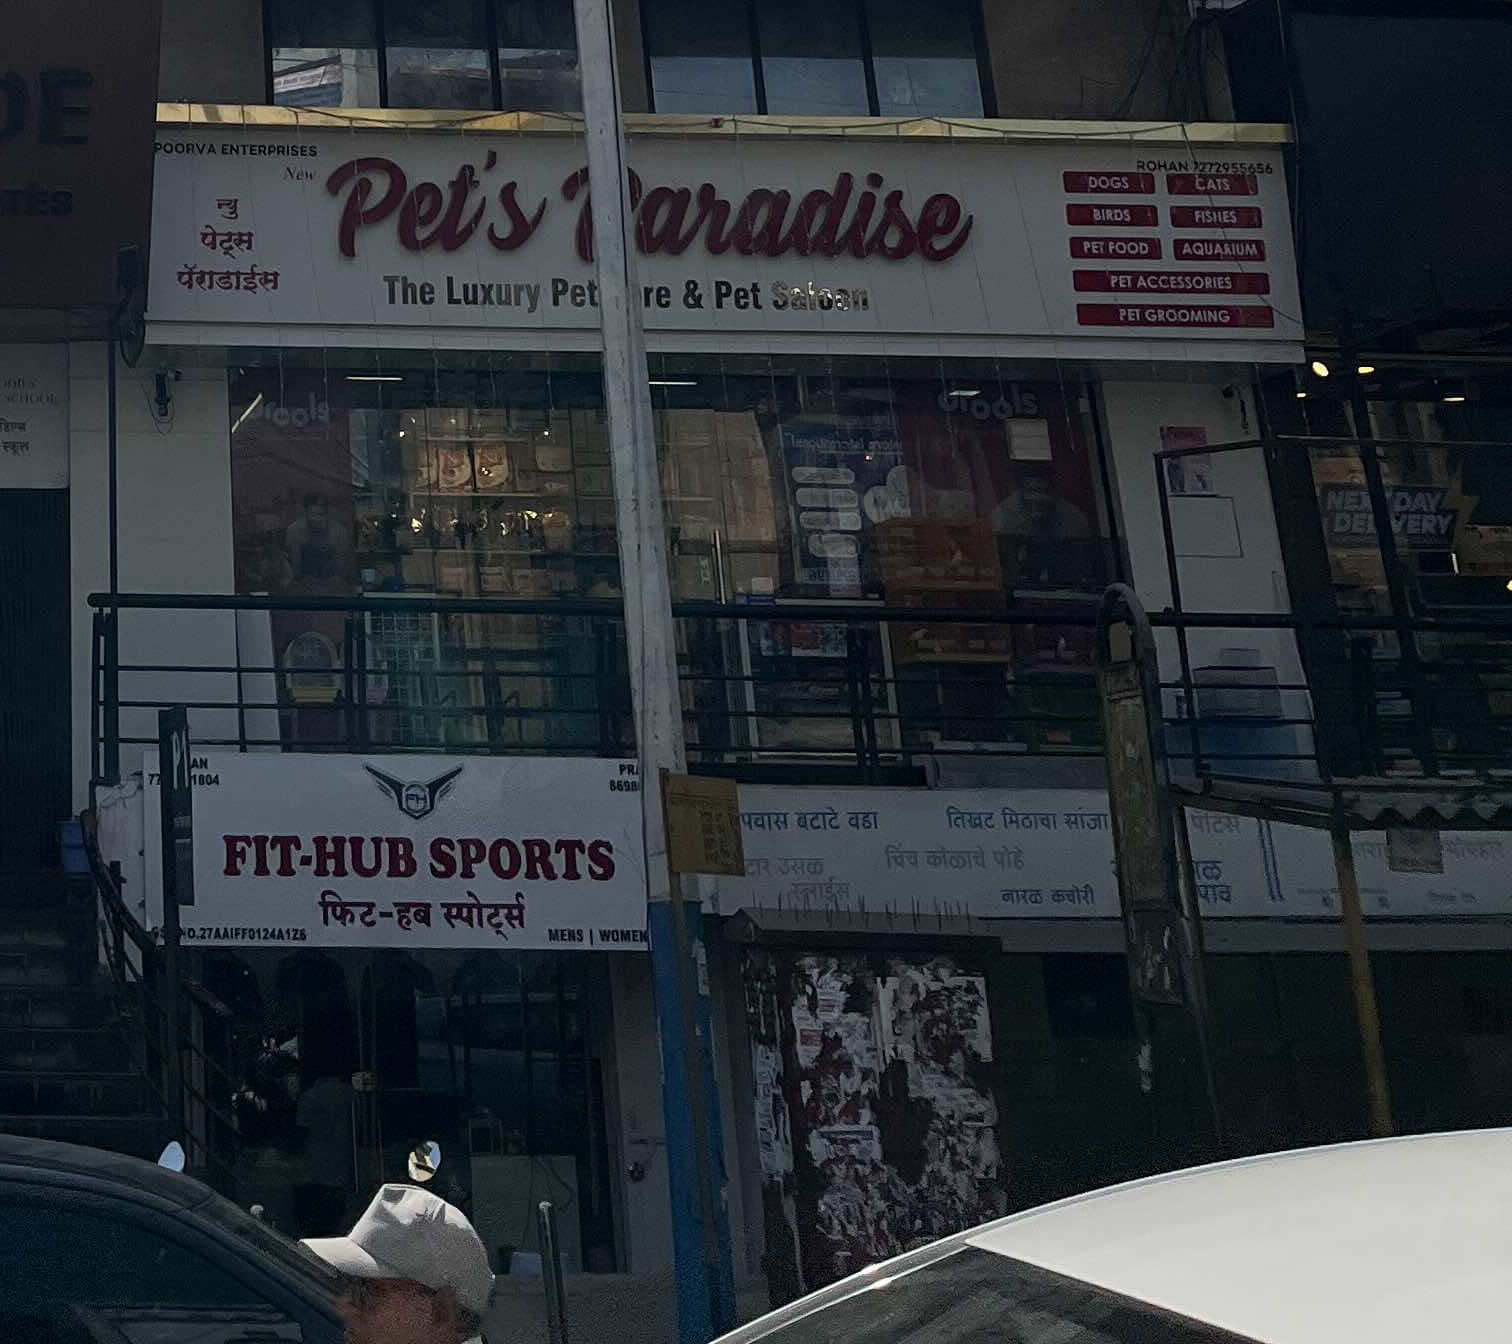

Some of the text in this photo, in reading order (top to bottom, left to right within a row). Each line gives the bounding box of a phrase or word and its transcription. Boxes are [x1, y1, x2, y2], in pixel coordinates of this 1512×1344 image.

[153, 141, 318, 157] POORVA ENTERPRISES
[283, 165, 314, 181] New
[1136, 160, 1189, 172] ROHAN
[1088, 175, 1130, 190] DOGS
[1194, 176, 1232, 192] CATS
[326, 148, 548, 259] Pet's
[1092, 207, 1132, 223] BIRDS
[1193, 209, 1238, 225] FISHES
[200, 224, 255, 260] पेट्स
[1082, 240, 1150, 256] PET FOOD
[1181, 242, 1258, 257] AQUARIUM
[1109, 274, 1233, 290] PET ACCESSORIES
[383, 275, 435, 306] The
[446, 275, 541, 313] Luxury
[551, 278, 599, 308] Pet
[714, 279, 763, 311] Pet
[1118, 307, 1232, 324] PET GROOMING
[795, 806, 841, 831] बटाटे
[946, 805, 996, 831] तिखट
[222, 833, 617, 882] FIT-HUB SPORTS
[991, 845, 1025, 871] पोहे
[999, 883, 1095, 905] नारळ कचोरी
[317, 889, 527, 940] फिट-हब स्पोर्ट्स
[548, 928, 585, 943] MENS
